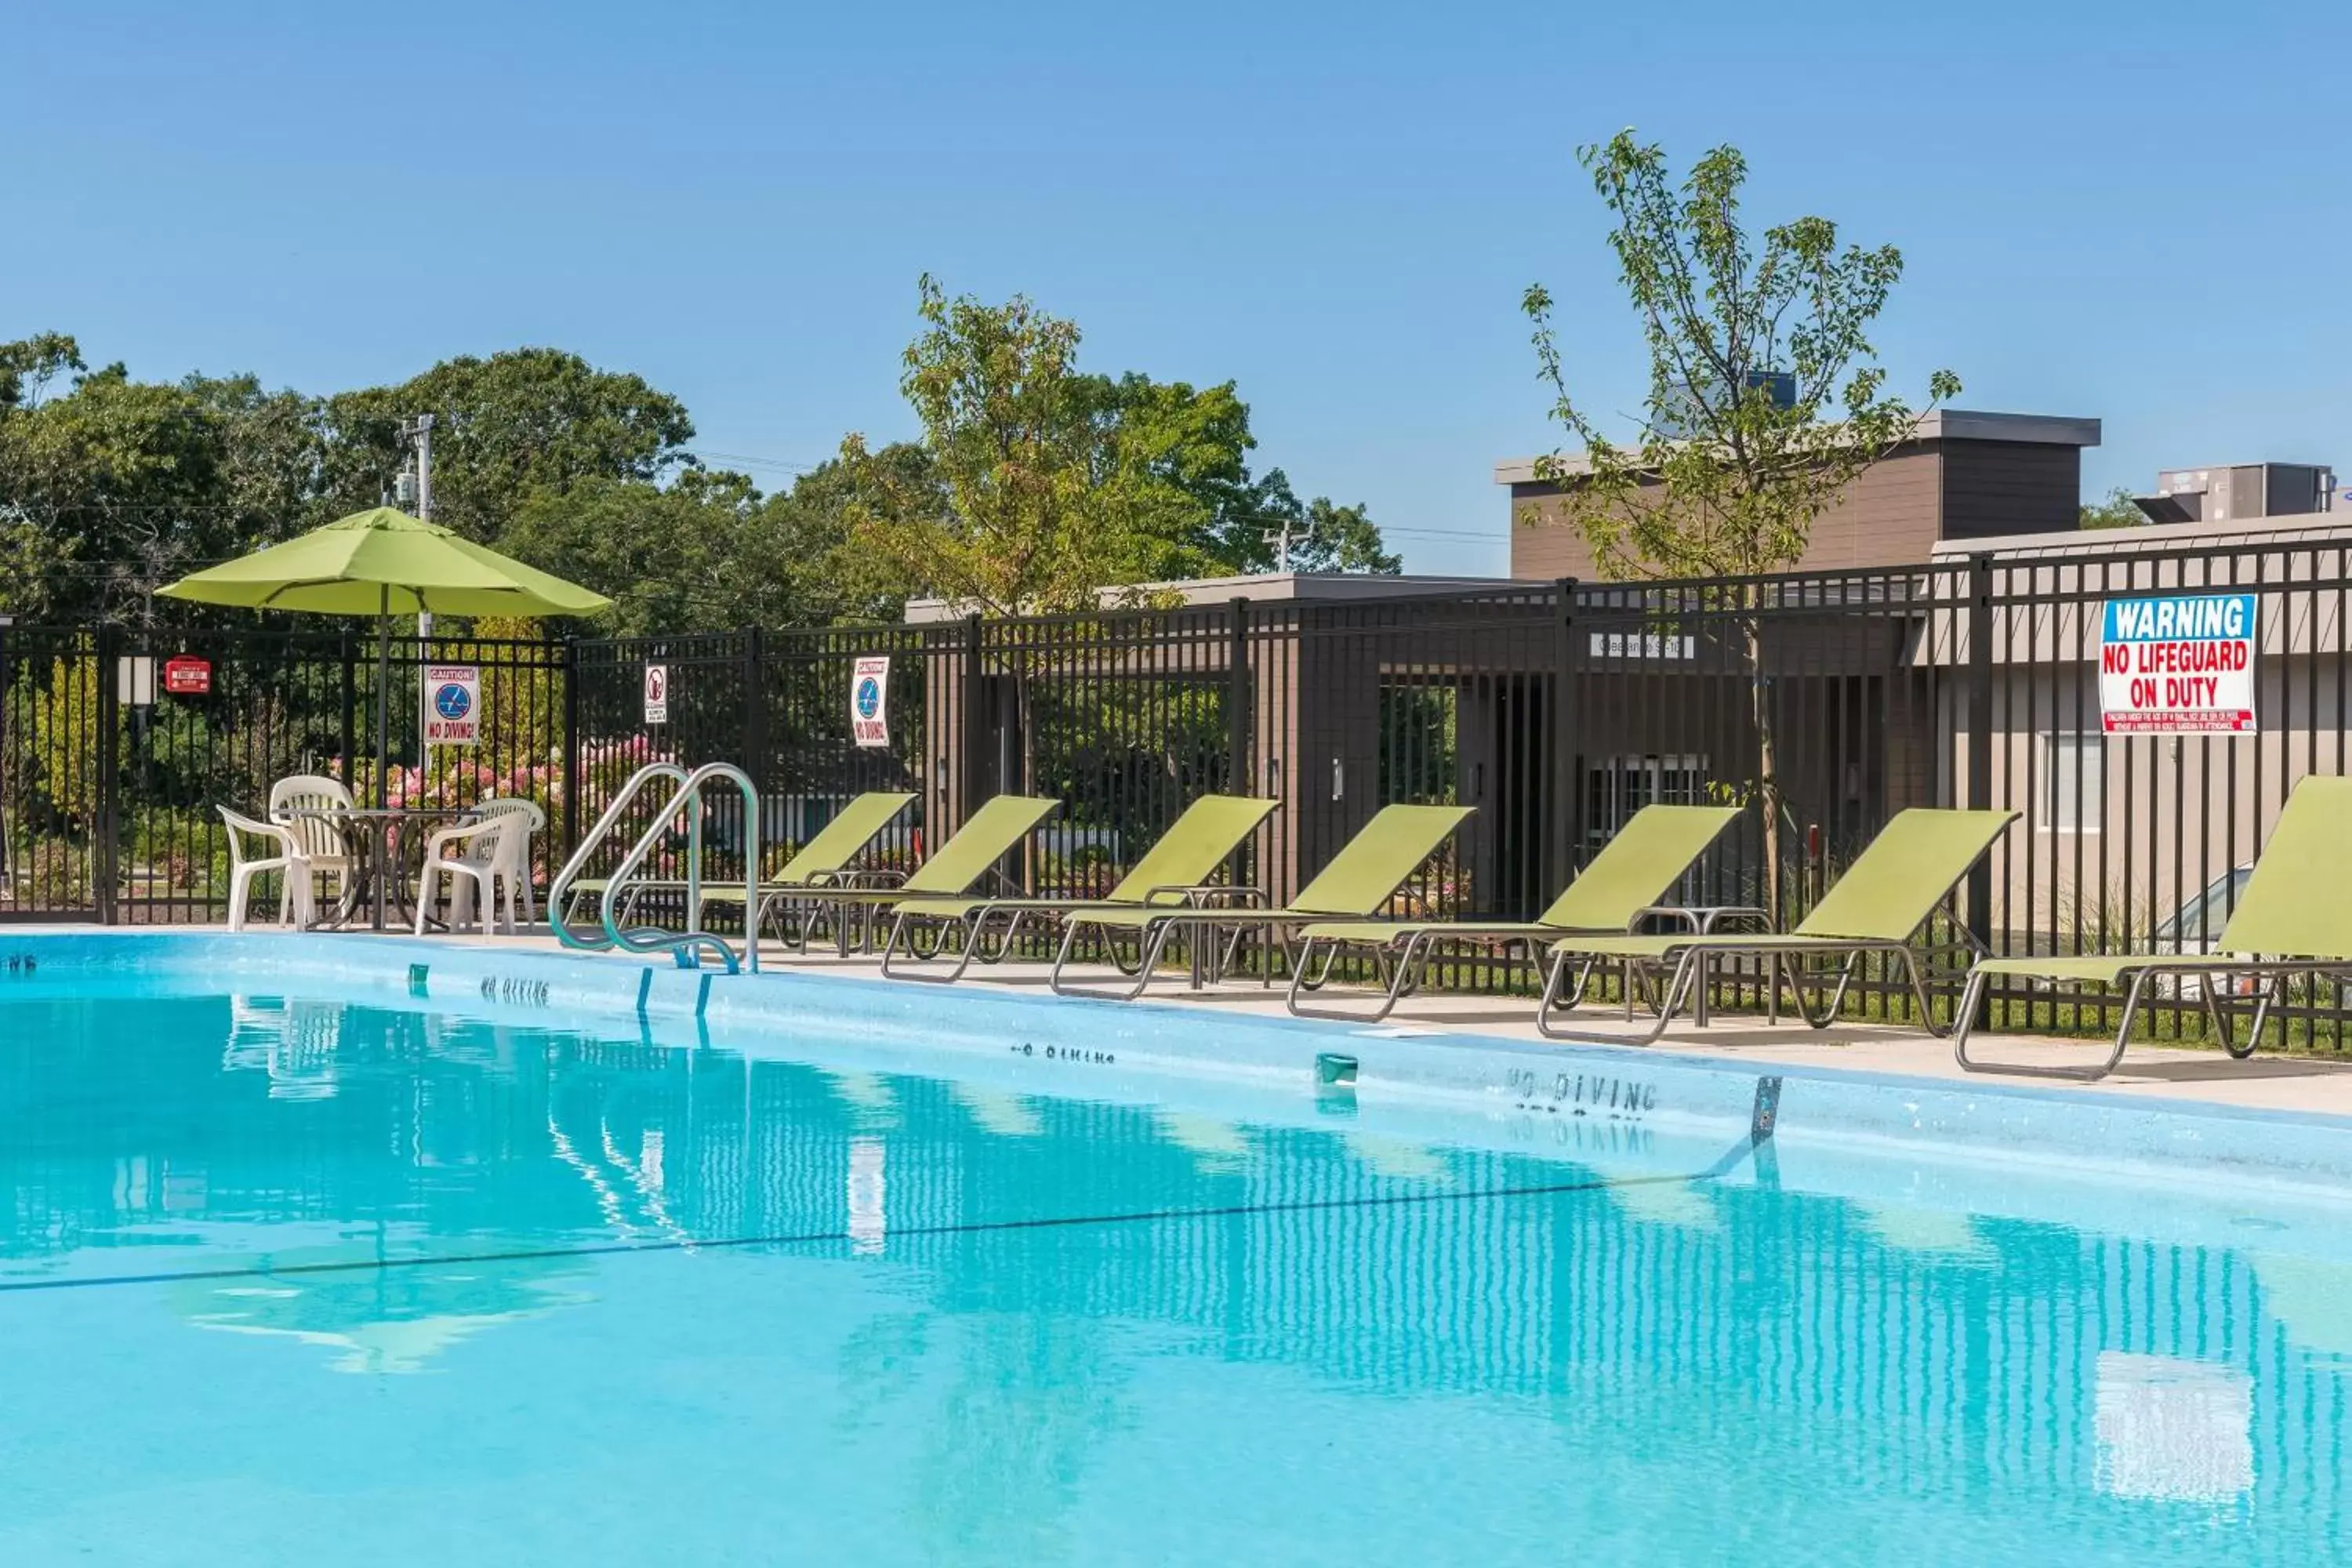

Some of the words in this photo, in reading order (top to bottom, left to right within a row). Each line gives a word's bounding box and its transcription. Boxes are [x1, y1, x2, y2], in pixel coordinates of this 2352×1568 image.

[2116, 598, 2243, 640] WARNING
[2103, 644, 2129, 674] NO
[2138, 641, 2247, 673] LIFEGUARD
[430, 670, 474, 681] CAUTION!
[2130, 677, 2158, 709] ON
[2166, 677, 2218, 708] DUTY
[429, 722, 441, 739] NO
[1555, 1073, 1657, 1111] DIVING
